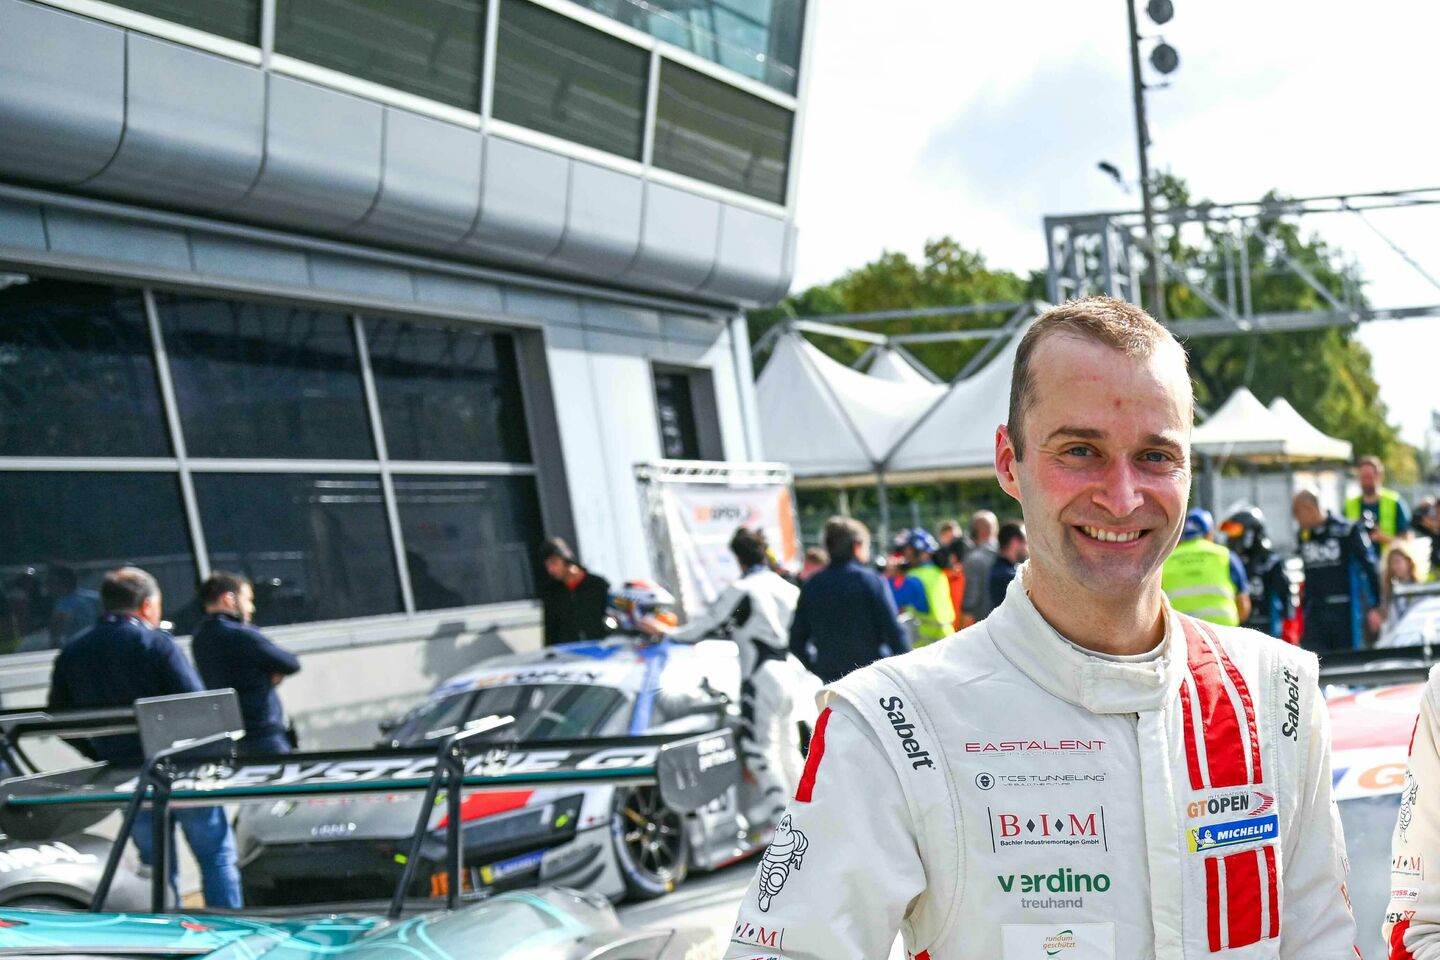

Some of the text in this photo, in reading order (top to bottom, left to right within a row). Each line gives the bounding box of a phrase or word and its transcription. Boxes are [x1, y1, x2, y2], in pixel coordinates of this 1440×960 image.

[1281, 670, 1300, 742] Sabelt
[879, 696, 933, 770] Sabelt
[965, 740, 1106, 753] EASTALENT
[1031, 774, 1105, 782] TUNNELING
[1217, 823, 1273, 841] MICHELIN
[997, 868, 1111, 893] verdino
[1021, 897, 1083, 909] treuhand
